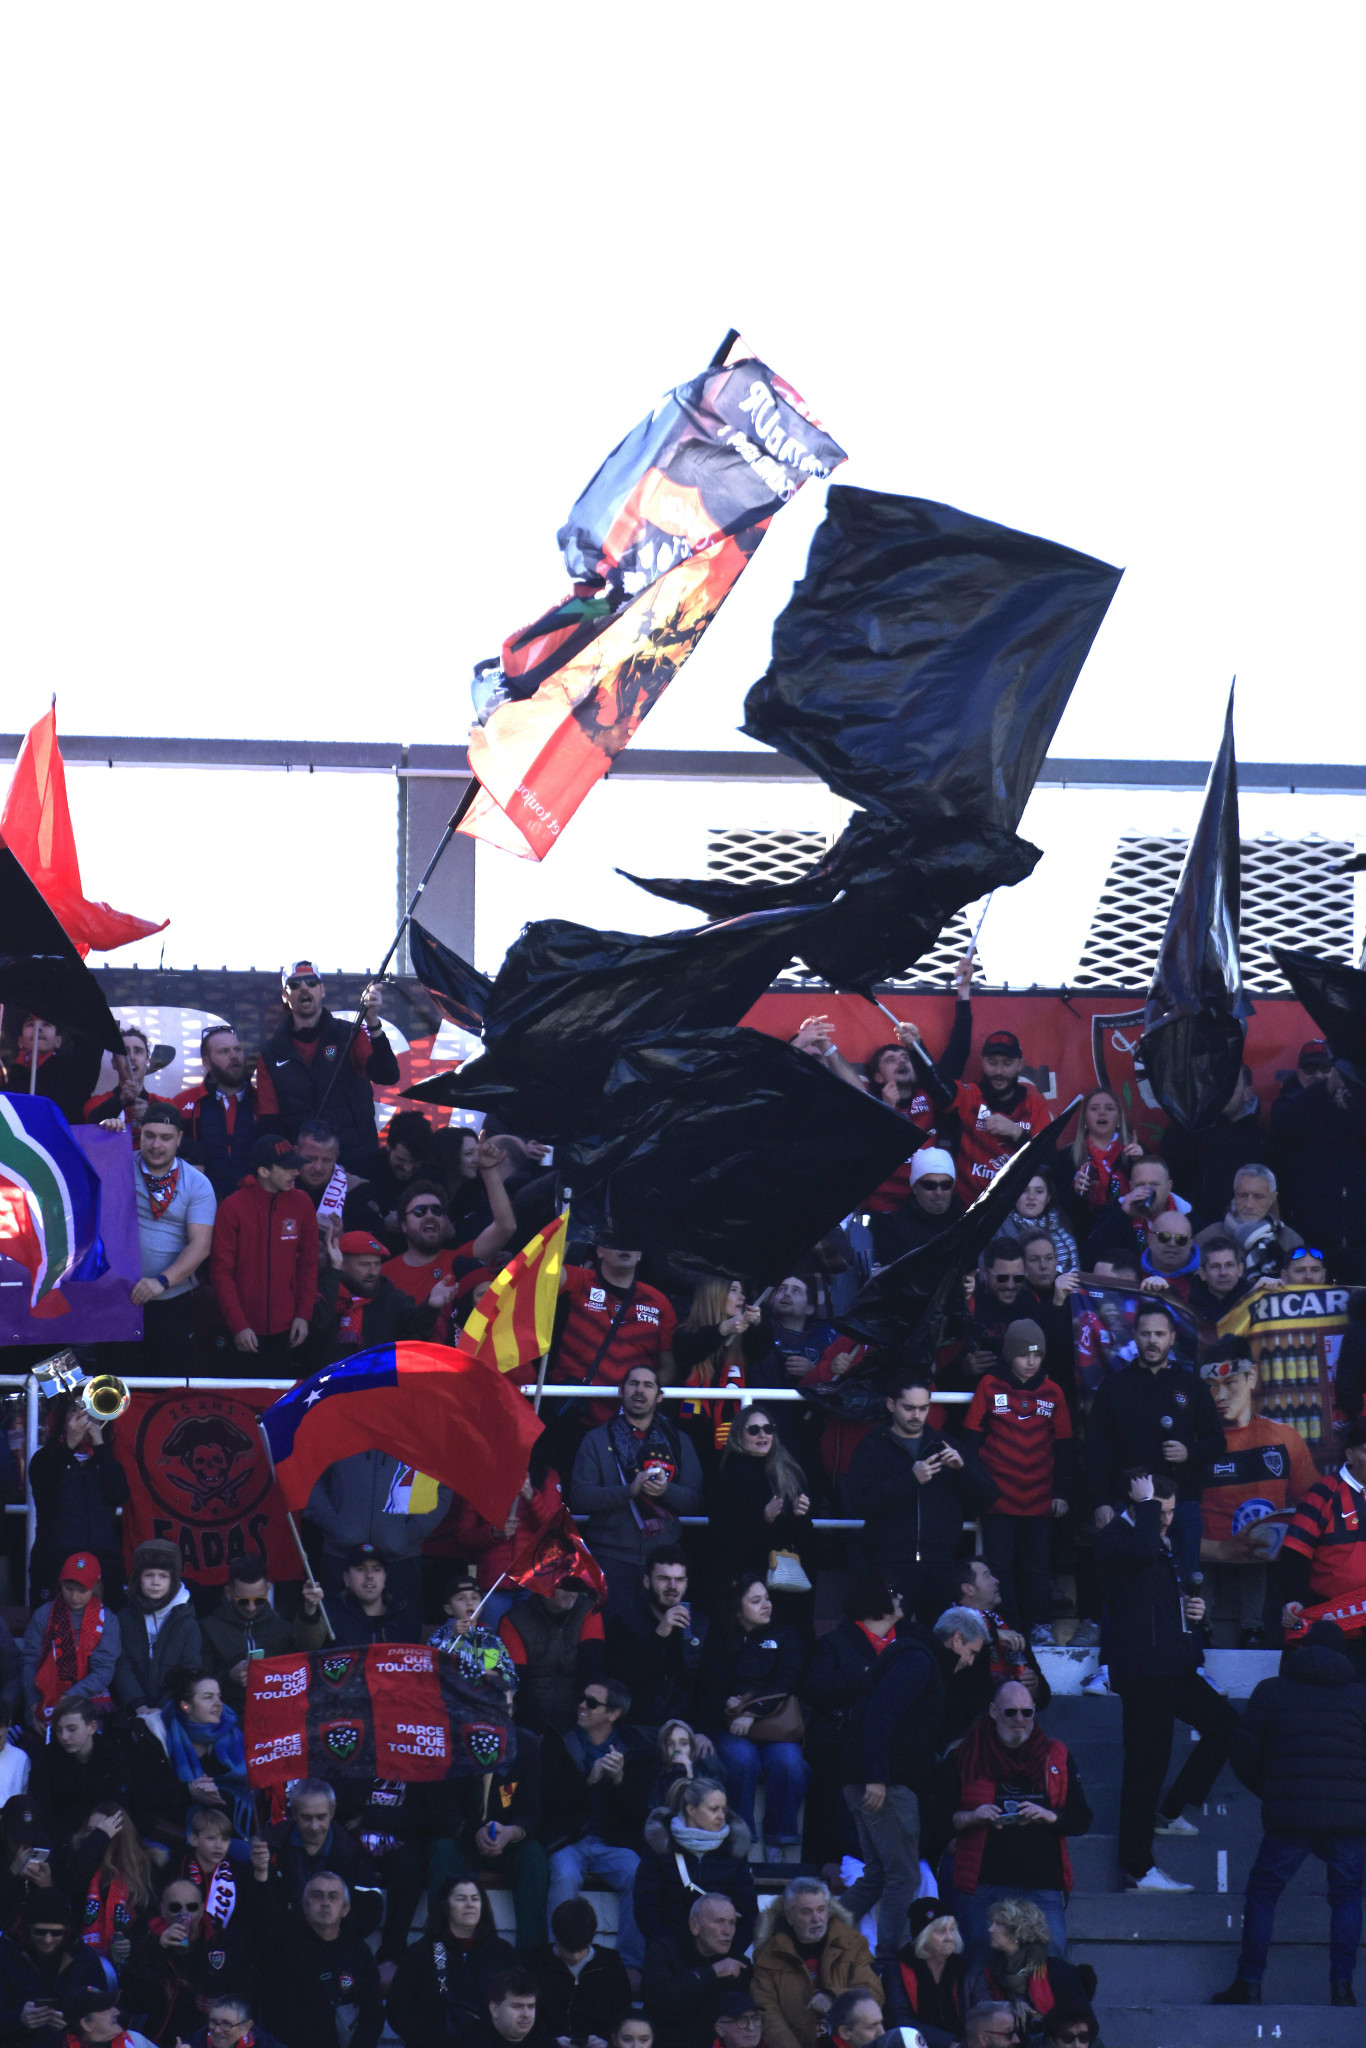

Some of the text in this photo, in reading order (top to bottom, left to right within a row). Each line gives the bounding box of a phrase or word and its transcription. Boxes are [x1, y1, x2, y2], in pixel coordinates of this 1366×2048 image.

[971, 1162, 999, 1180] Kin
[635, 1304, 660, 1315] TOULON
[168, 1403, 190, 1420] 25
[376, 1662, 434, 1673] TOULON
[403, 1655, 432, 1665] QUE
[264, 1666, 307, 1684] PARCE
[282, 1675, 307, 1691] QUE
[252, 1683, 307, 1701] TOULON
[396, 1723, 445, 1737] PARCE
[254, 1733, 301, 1751] PARCE
[272, 1743, 302, 1754] QUE
[415, 1735, 446, 1748] QUE
[387, 1742, 446, 1758] TOULON
[248, 1749, 302, 1768] TOULON
[1203, 1802, 1228, 1816] 16
[1258, 2024, 1281, 2038] 14
